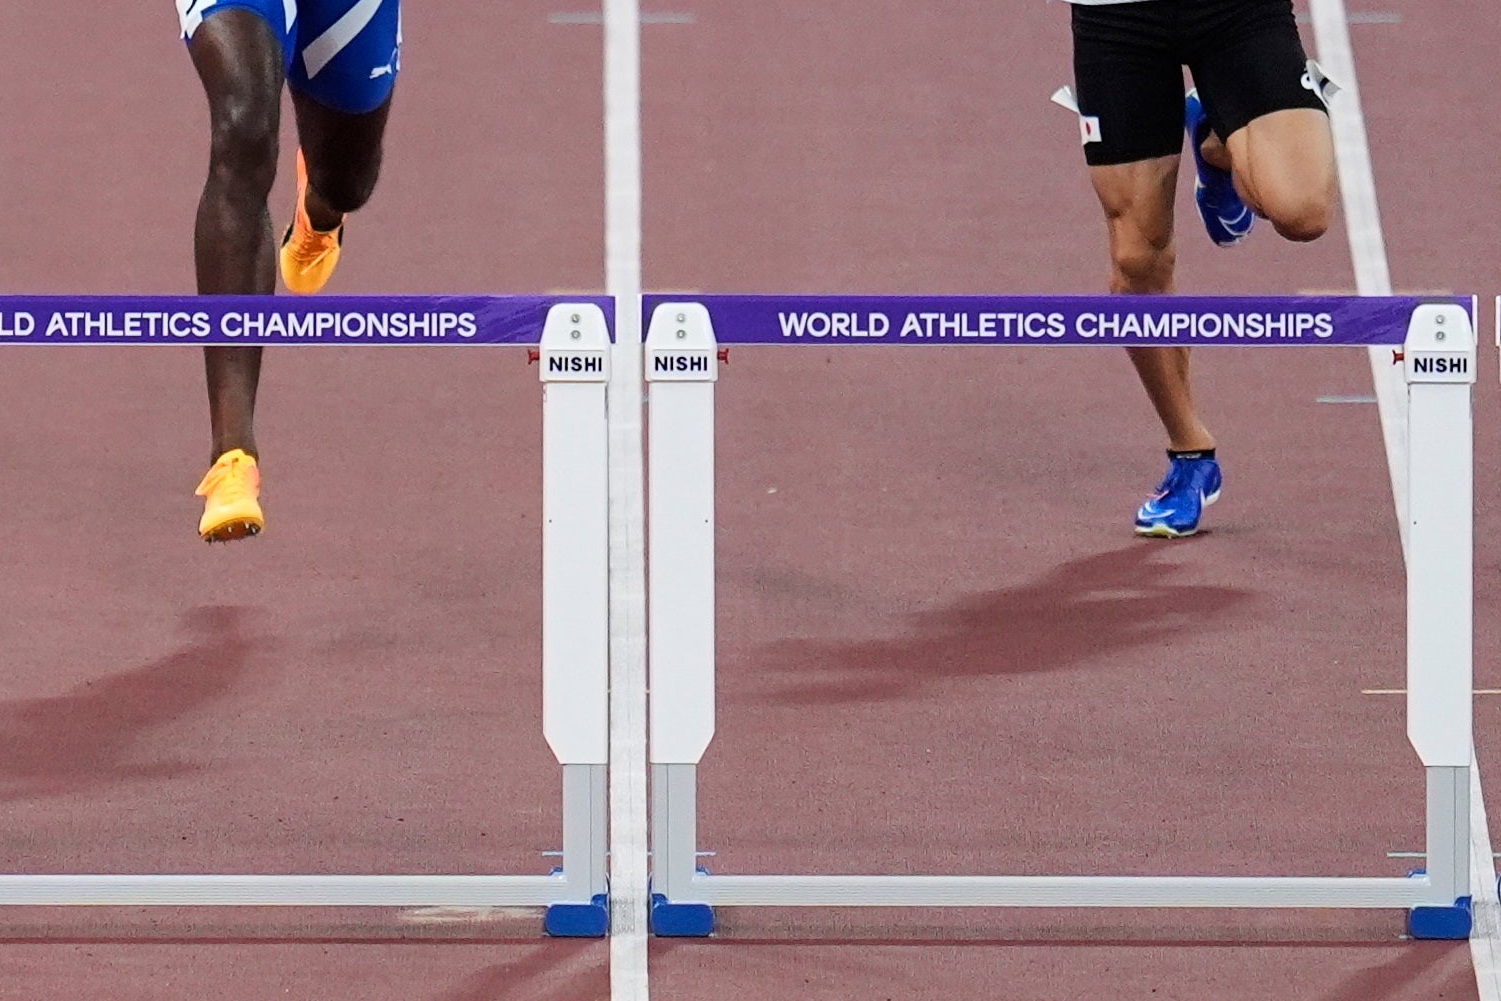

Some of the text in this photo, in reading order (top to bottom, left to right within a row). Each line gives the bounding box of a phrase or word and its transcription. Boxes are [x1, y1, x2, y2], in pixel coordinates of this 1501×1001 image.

[45, 311, 211, 337] ATHLETICS
[220, 312, 477, 338] CHAMPIONSHIPS
[778, 312, 1333, 338] WORLD ATHLETICS CHAMPIONSHIPS
[549, 356, 602, 372] NISHI
[654, 356, 708, 372] NISHI
[1414, 357, 1467, 373] NISHI
